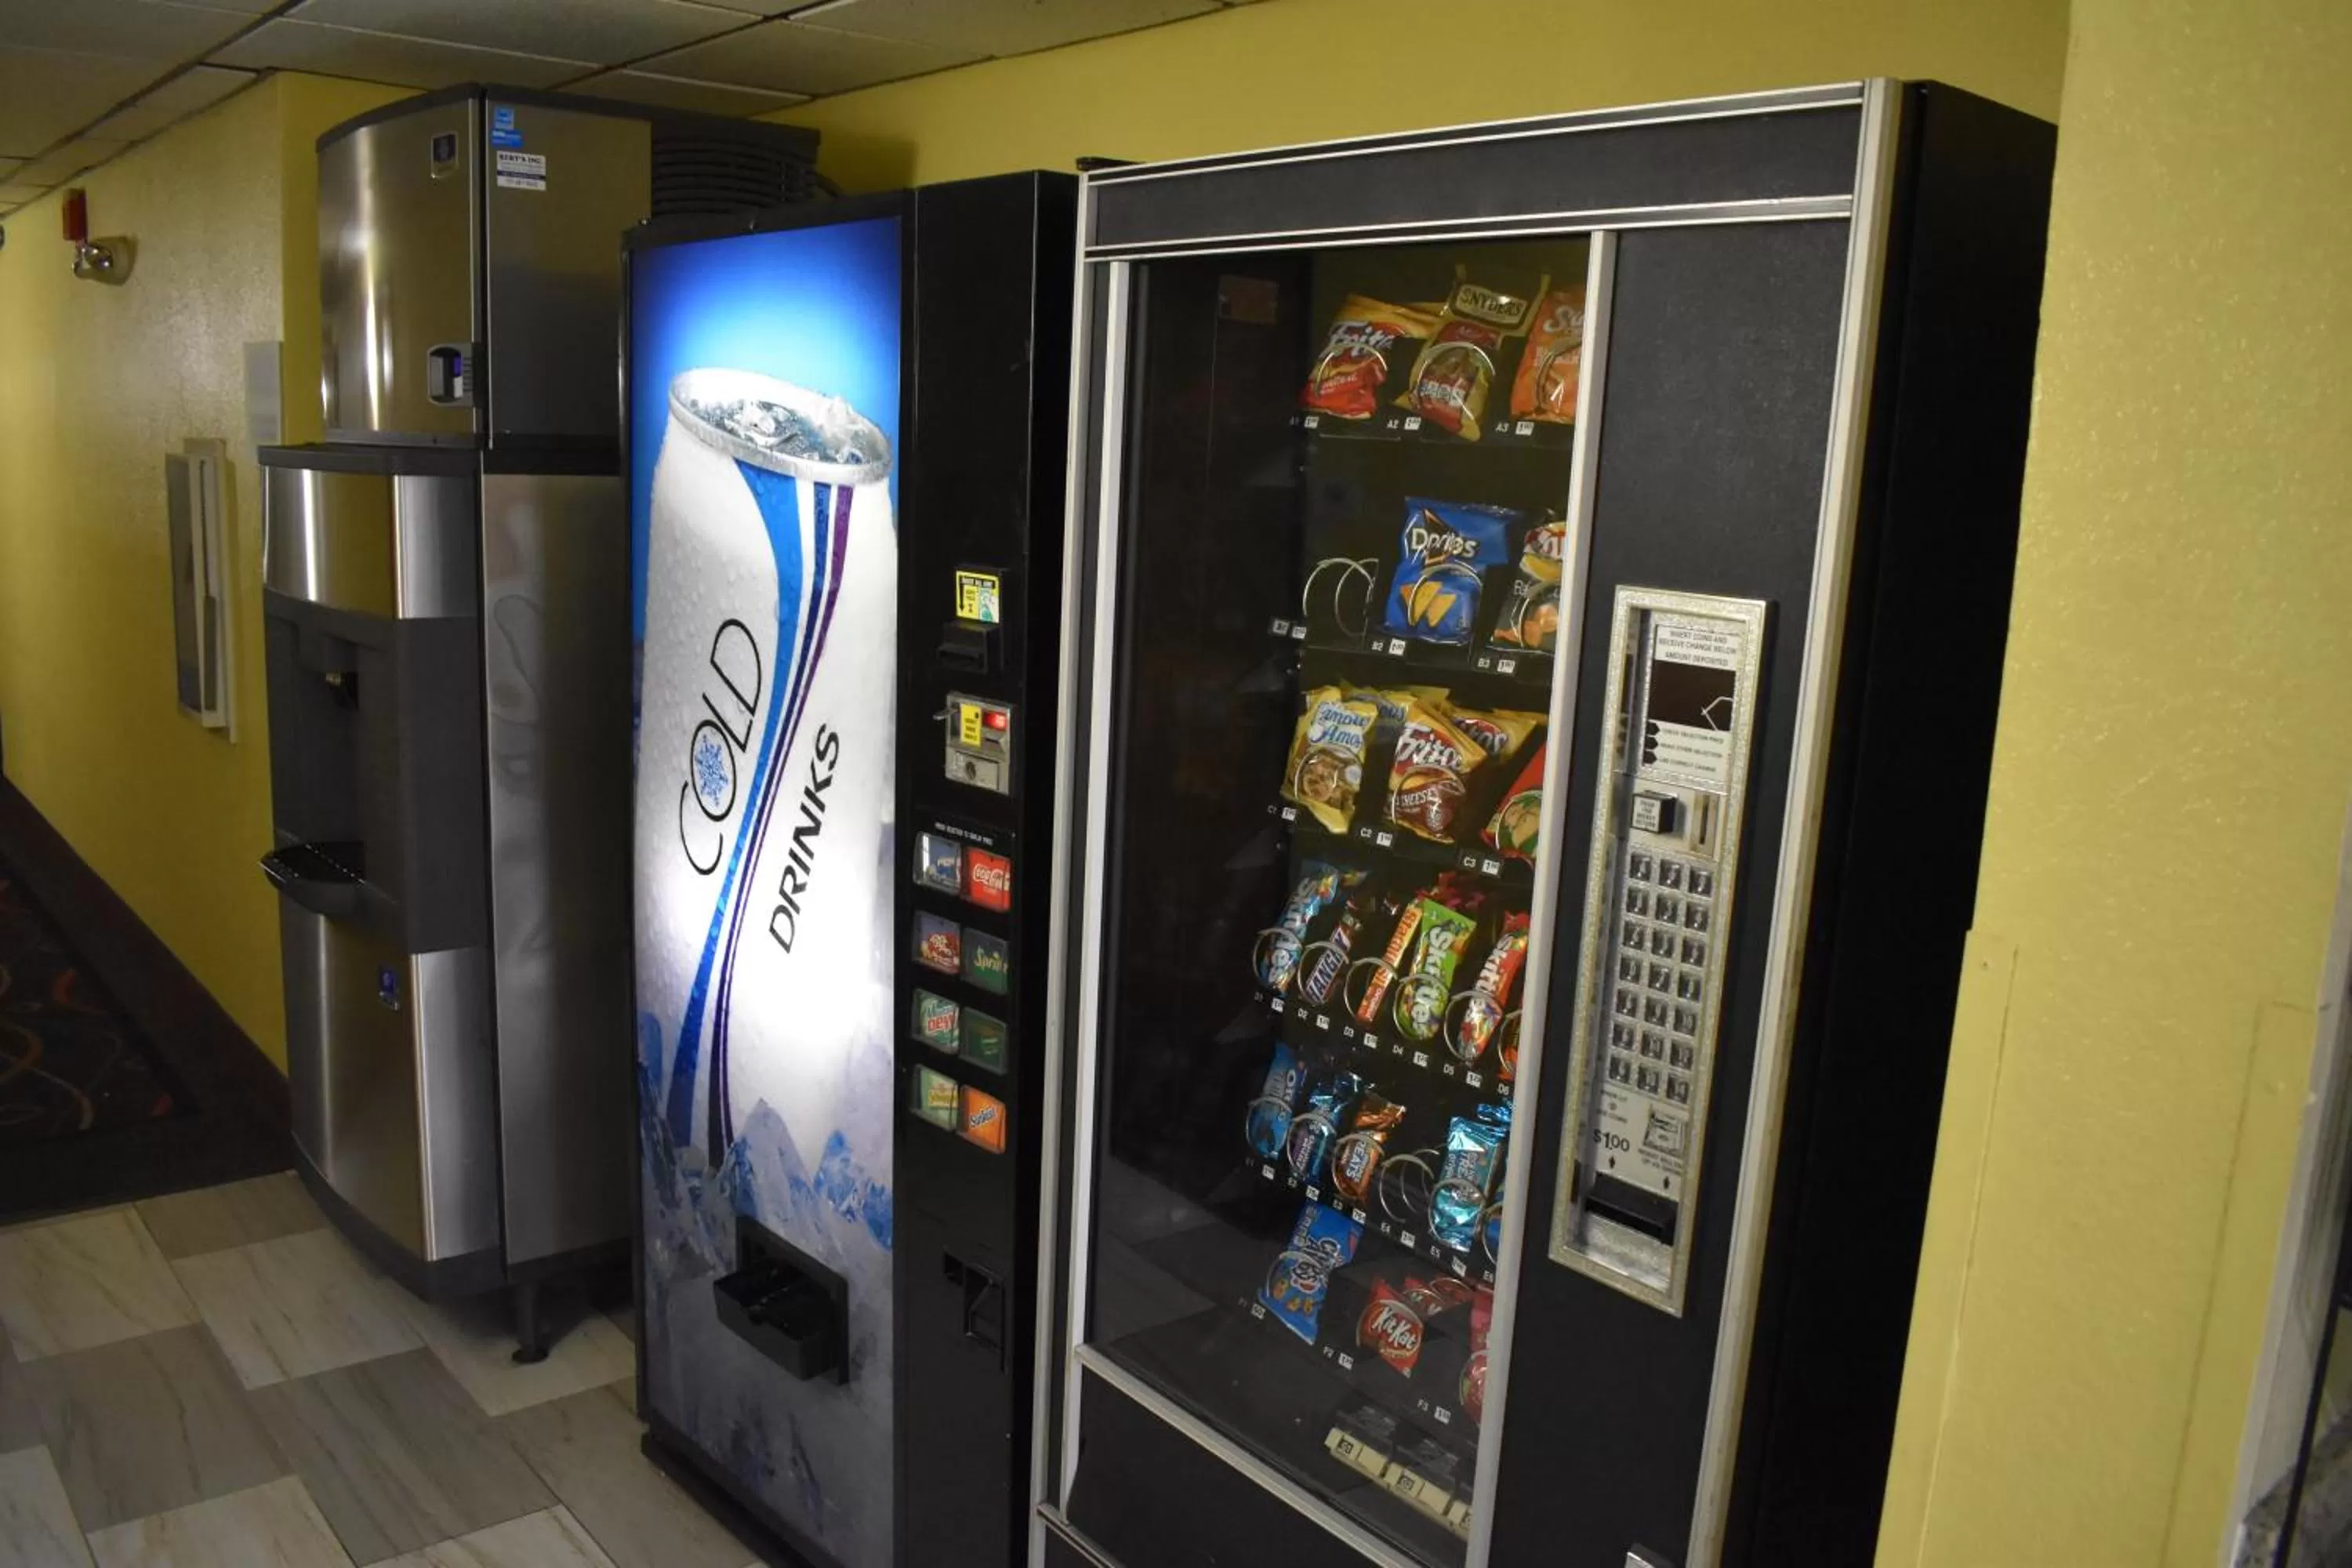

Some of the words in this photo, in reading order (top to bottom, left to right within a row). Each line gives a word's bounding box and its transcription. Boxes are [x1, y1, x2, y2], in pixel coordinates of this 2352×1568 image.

[1387, 419, 1399, 429] A2
[1496, 423, 1509, 433] A3
[1411, 527, 1478, 558] Doritos
[680, 618, 762, 877] COLD
[768, 723, 840, 954] DRINKS
[1361, 828, 1373, 838] C2
[1464, 856, 1477, 867] C3
[1411, 925, 1455, 1040] Skitles
[1298, 1007, 1308, 1019] D2
[1392, 1044, 1404, 1055] D4
[1443, 1063, 1455, 1075] D5
